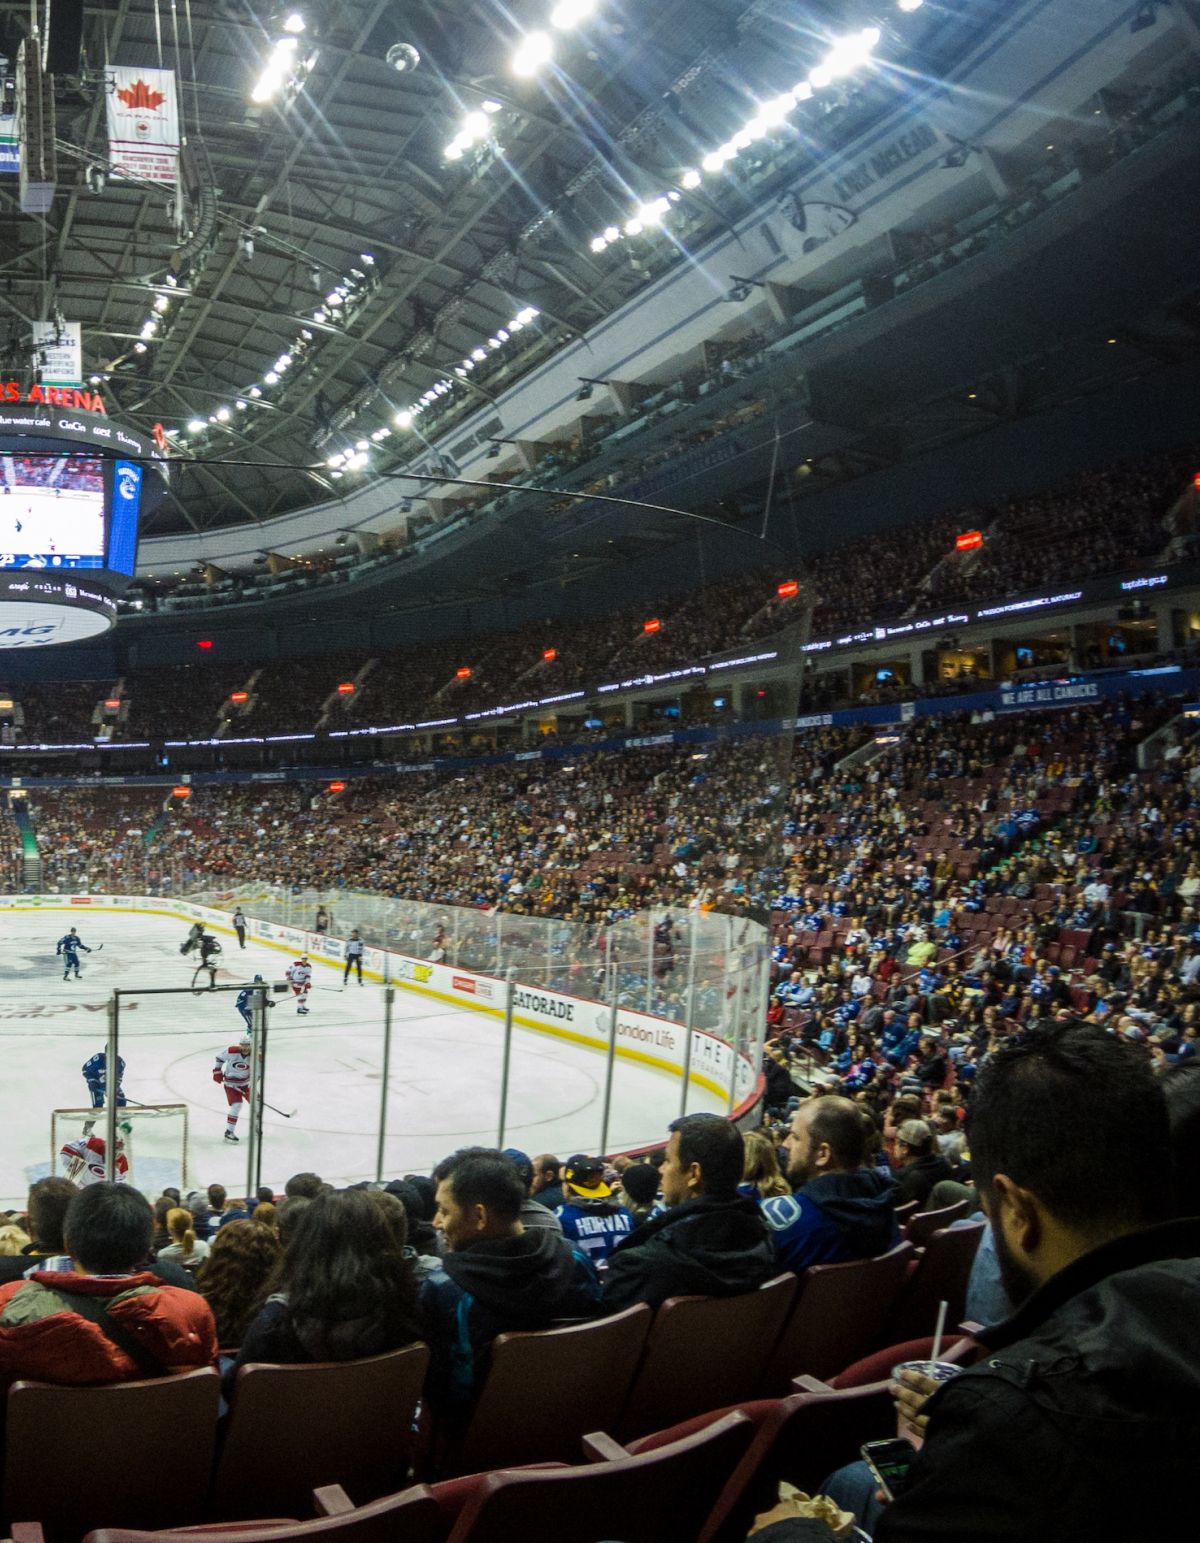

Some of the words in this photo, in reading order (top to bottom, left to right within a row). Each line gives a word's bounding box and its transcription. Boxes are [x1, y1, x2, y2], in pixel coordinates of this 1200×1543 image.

[27, 384, 106, 415] ARENA
[1002, 692, 1016, 705] WE
[1017, 690, 1035, 703] ARE
[1036, 688, 1053, 701] ALL
[1054, 683, 1098, 699] CANUCKS
[511, 988, 575, 1022] GATORADE
[617, 1023, 654, 1044] ondon
[656, 1029, 676, 1050] Life
[574, 1214, 631, 1237] HORVAT
